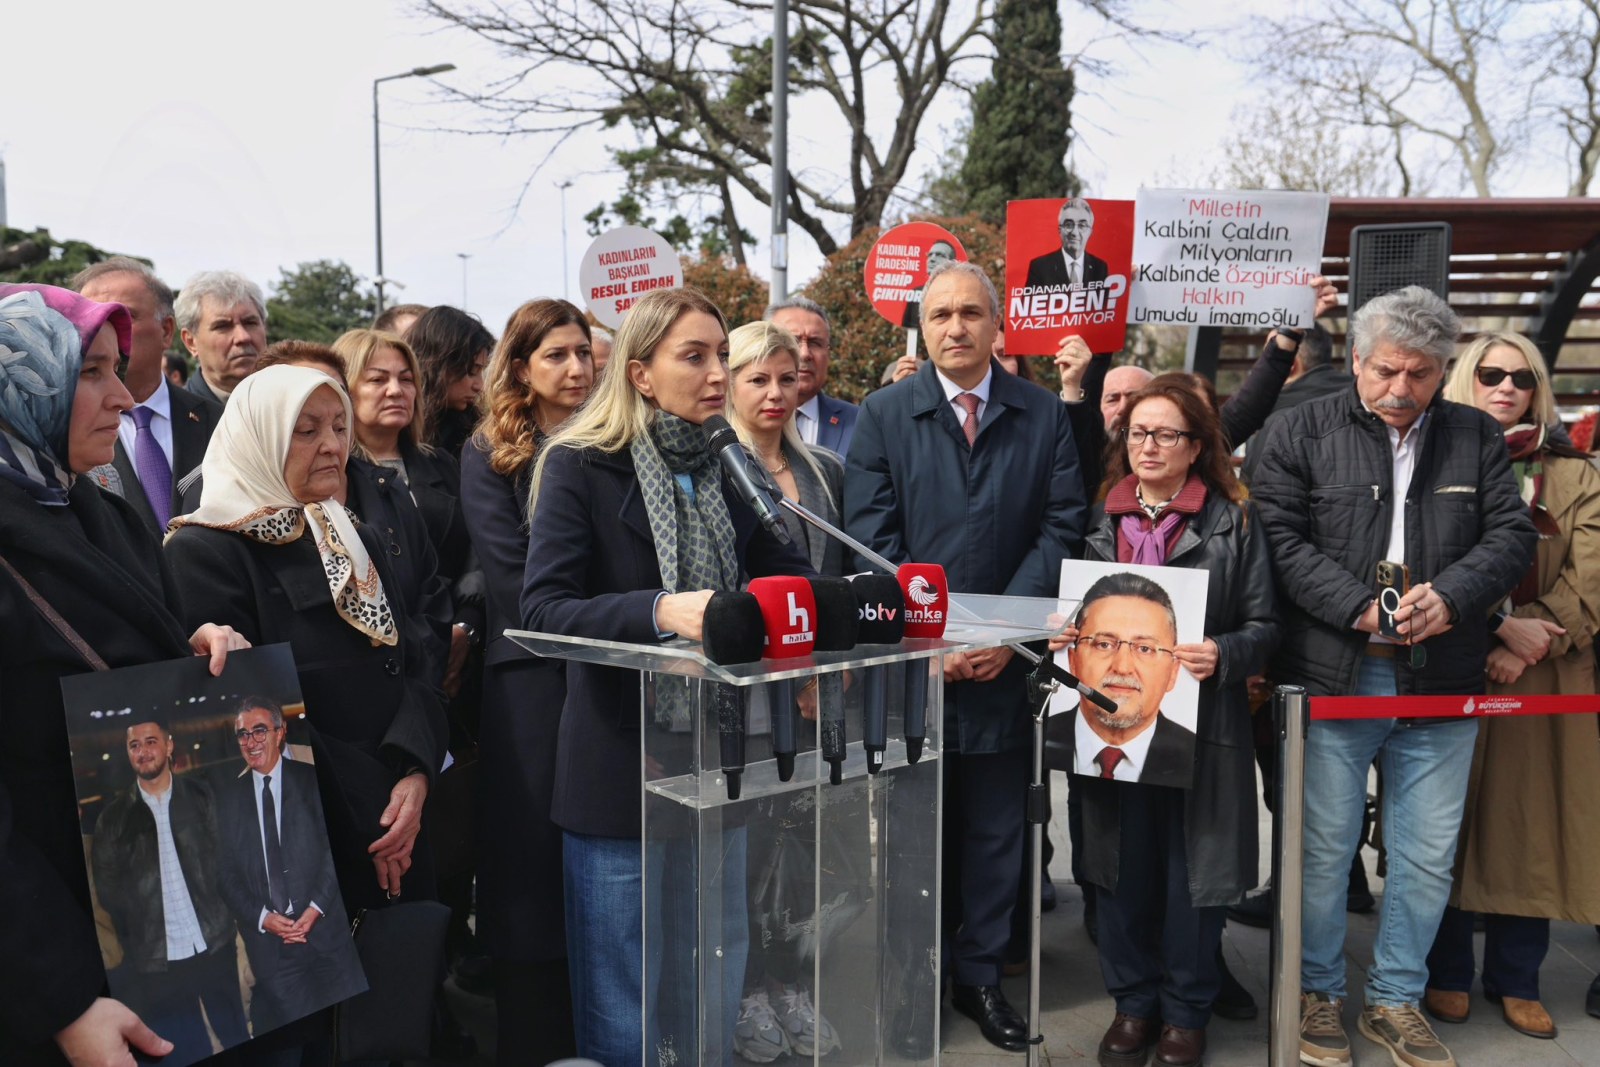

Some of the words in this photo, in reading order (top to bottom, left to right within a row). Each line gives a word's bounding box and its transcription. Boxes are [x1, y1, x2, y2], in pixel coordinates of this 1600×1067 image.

[1189, 198, 1262, 218] Milletin
[1145, 219, 1211, 238] Kalbini
[598, 246, 657, 266] KADINLARIN
[877, 244, 921, 258] KADINLAR
[1180, 243, 1292, 266] Milyonların
[608, 264, 650, 281] BAŞKANI
[875, 256, 920, 272] İRADESİNE
[873, 271, 913, 287] SAHİP
[1139, 263, 1220, 283] Kalbinde
[591, 283, 628, 300] RESUL
[631, 275, 674, 293] EMRAH
[1011, 280, 1104, 297] İDDİANAMELER
[1182, 287, 1245, 305] Halkın
[1010, 310, 1115, 331] YAZILMIYOR
[1135, 306, 1198, 323] Umudu
[905, 606, 943, 620] anka
[789, 633, 808, 643] halk
[1478, 701, 1522, 710] BÜYÜKŞEHİR
